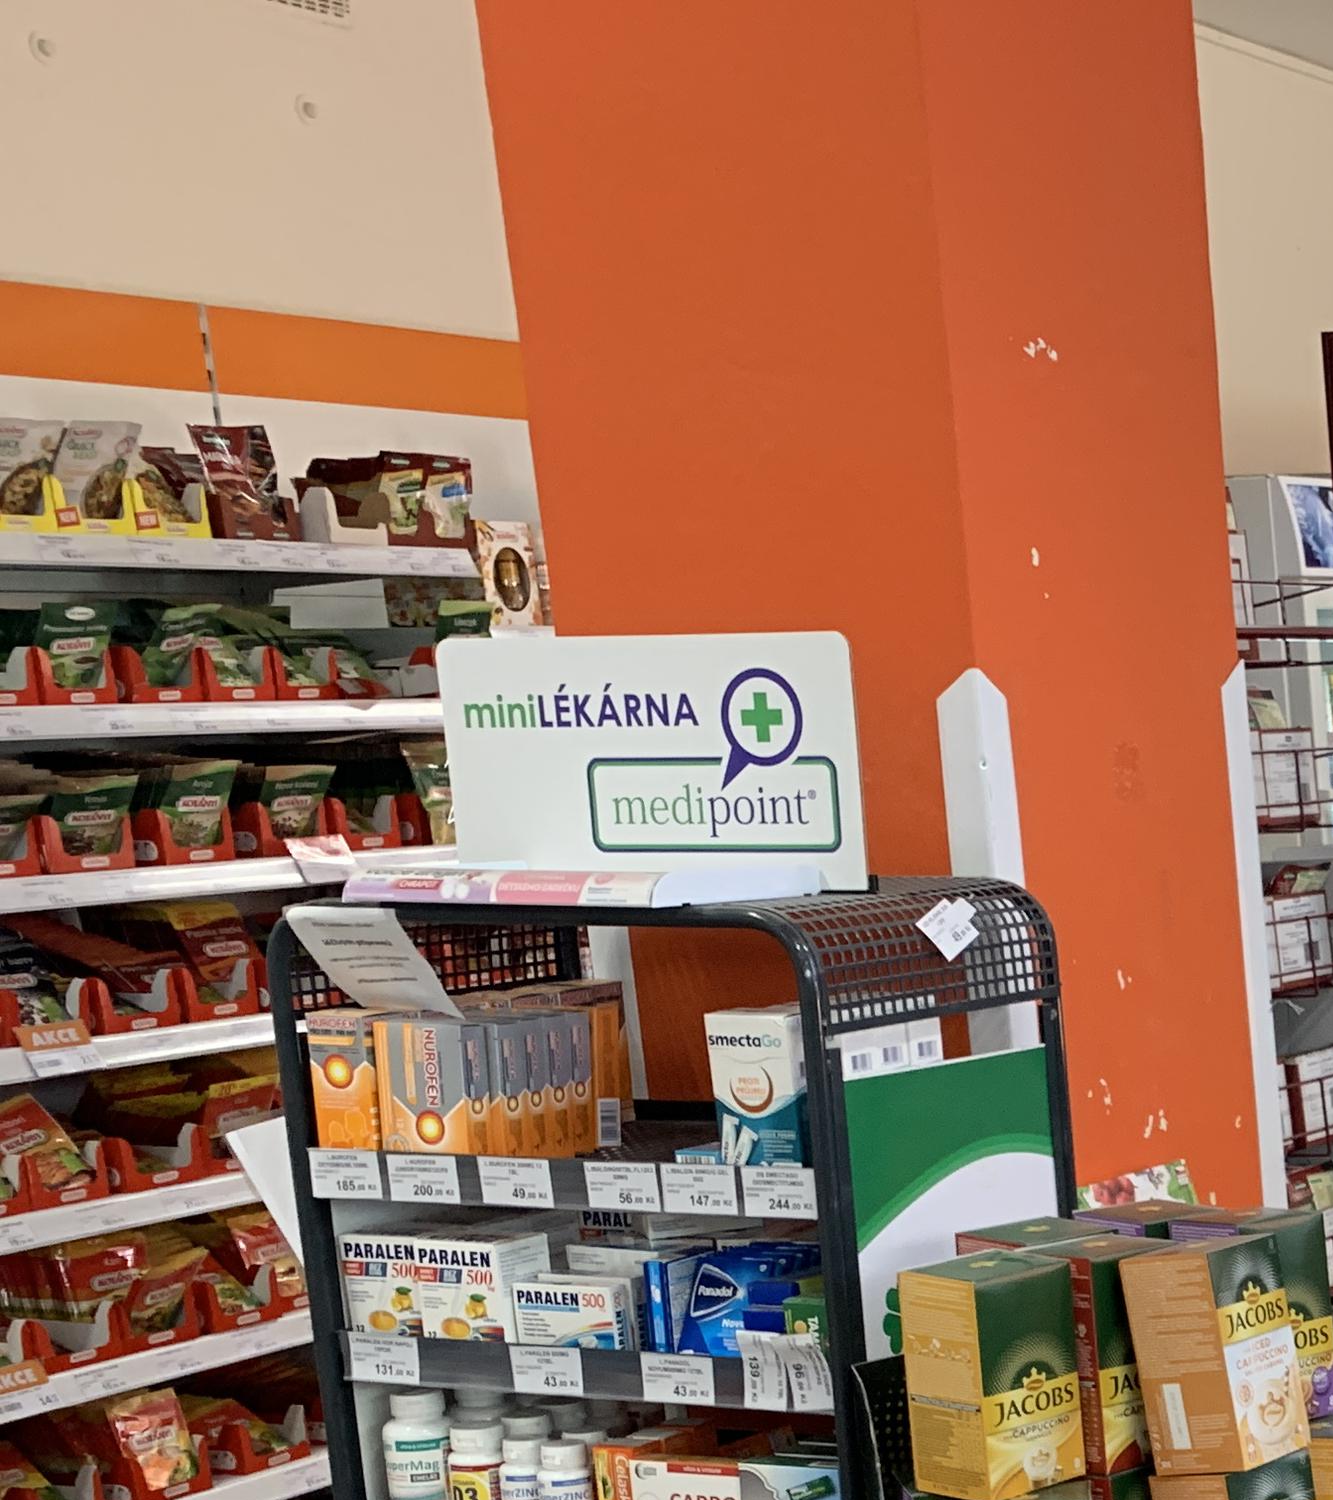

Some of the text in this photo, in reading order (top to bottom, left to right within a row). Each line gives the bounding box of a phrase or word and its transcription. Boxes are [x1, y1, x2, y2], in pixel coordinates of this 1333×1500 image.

[463, 682, 700, 730] miniLÉKÁRNA
[707, 1033, 783, 1050] smectaGo
[422, 1028, 440, 1107] NUROFEN
[582, 1211, 632, 1228] PARAL
[343, 1241, 415, 1262] PARALEN
[418, 1246, 492, 1268] PARALEN
[465, 1268, 493, 1287] 500
[517, 1289, 606, 1309] PARALEN 500
[697, 1283, 735, 1299] Panadol
[1225, 1295, 1285, 1339] JACOBS
[994, 1382, 1075, 1428] JACOBS
[1011, 1414, 1071, 1438] CAPPUCCINO
